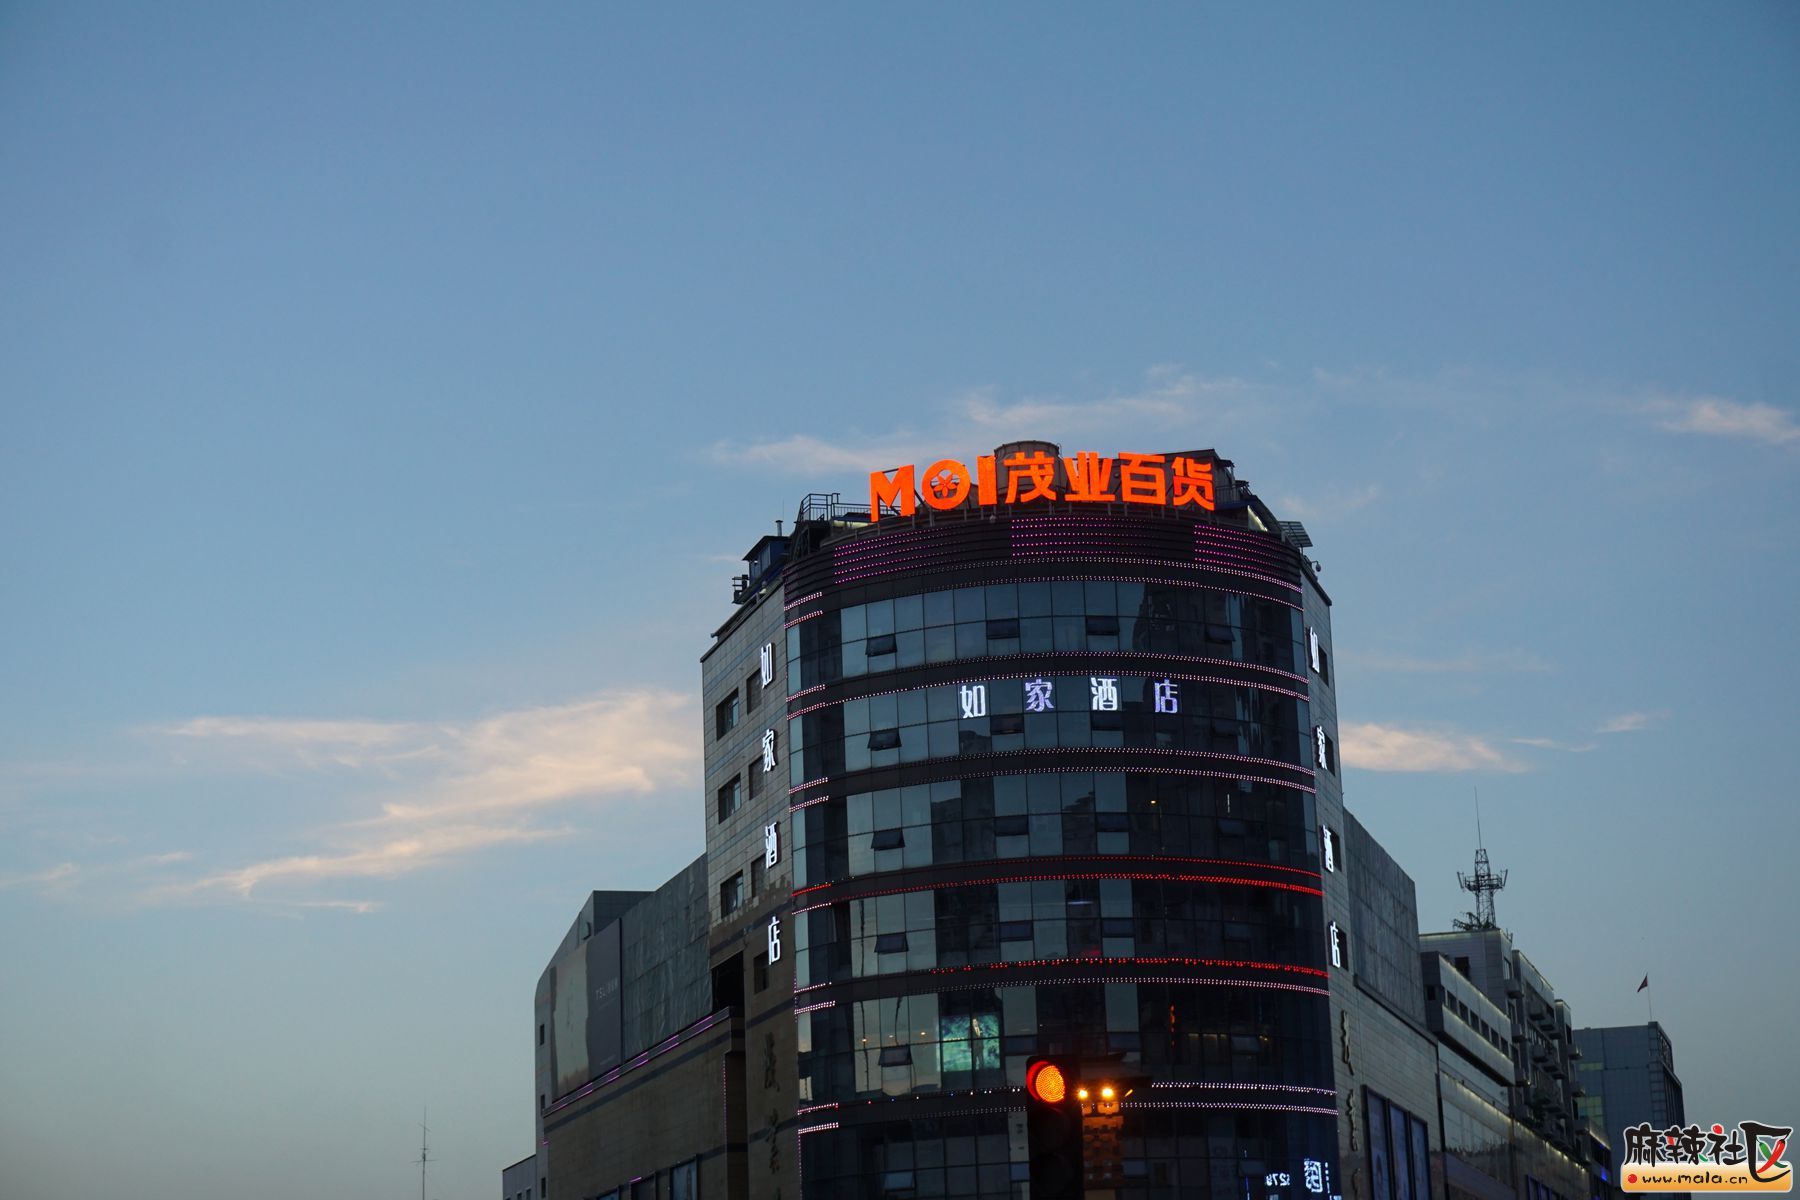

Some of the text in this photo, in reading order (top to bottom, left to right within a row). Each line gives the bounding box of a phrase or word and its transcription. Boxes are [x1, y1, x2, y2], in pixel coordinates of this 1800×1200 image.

[1003, 450, 1215, 511] 茂业百货
[958, 677, 1179, 719] 如家酒店
[760, 642, 781, 965] 如家酒店
